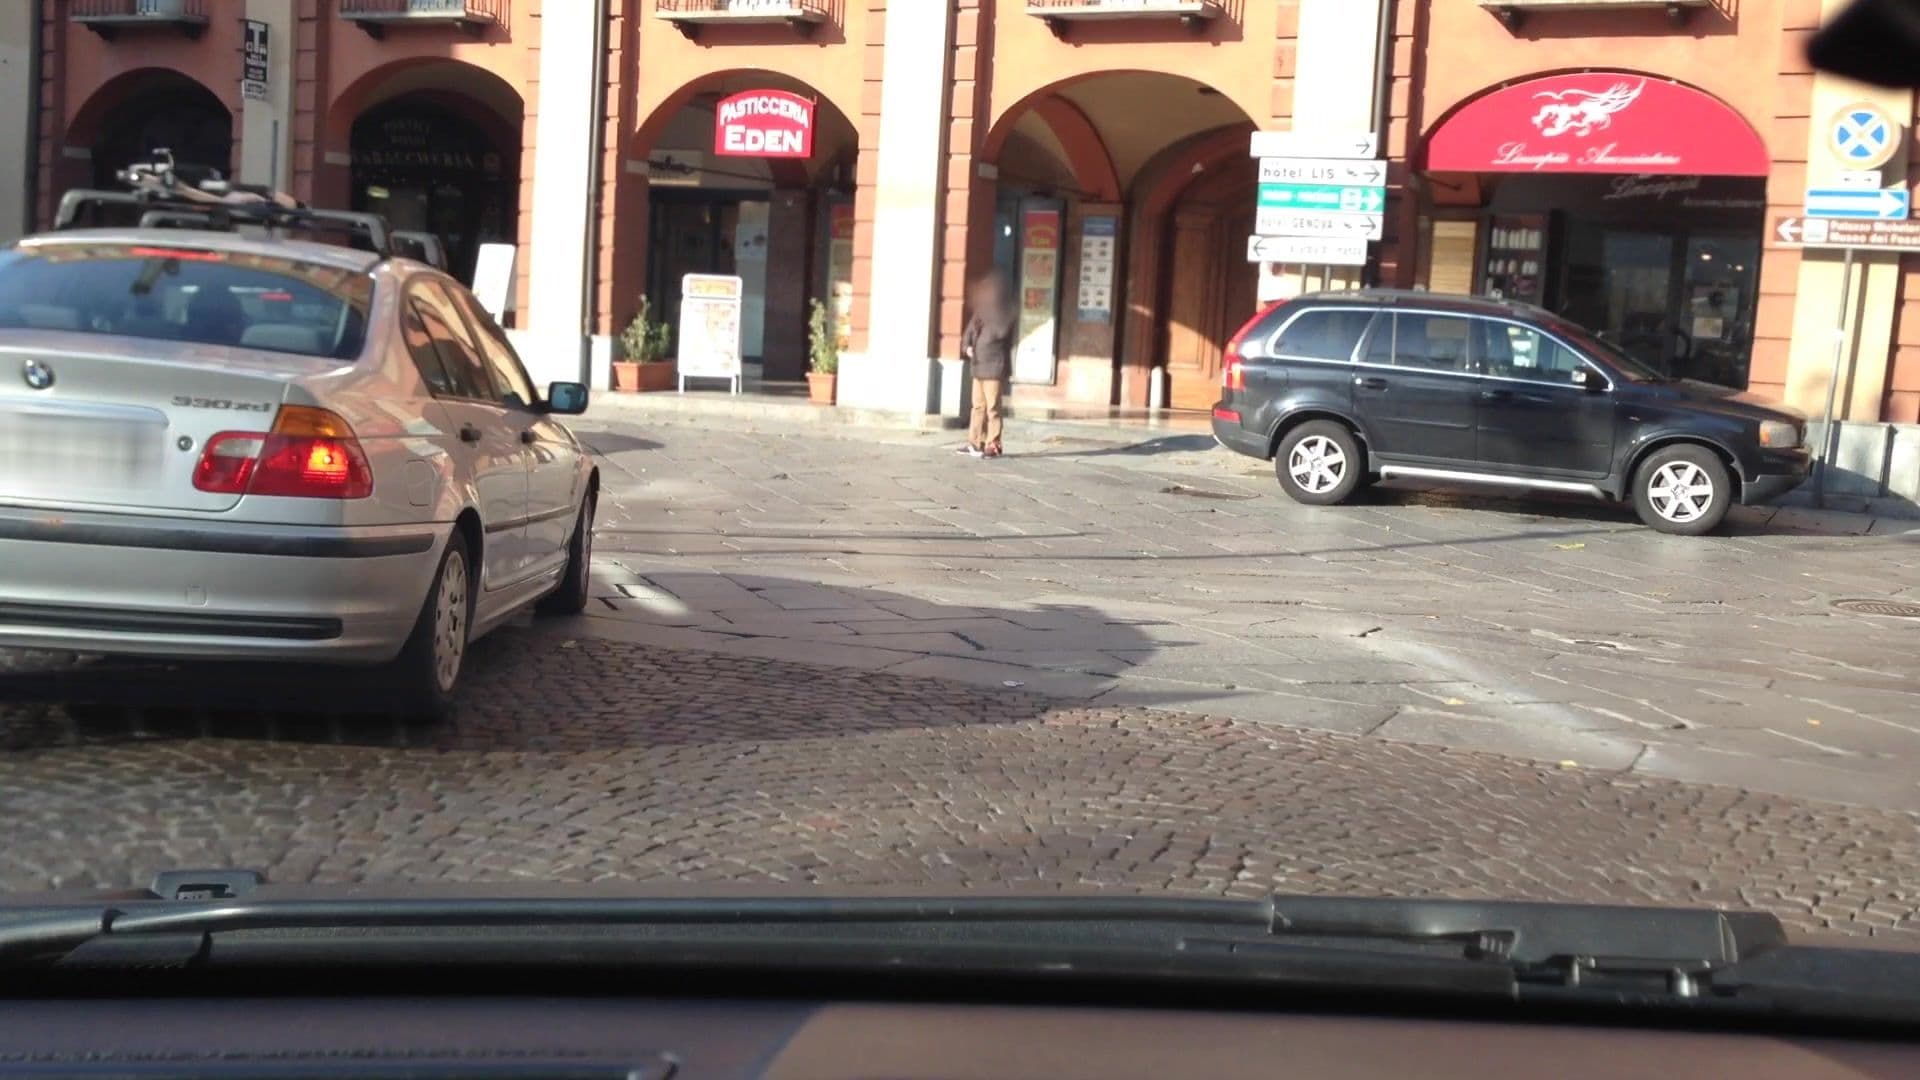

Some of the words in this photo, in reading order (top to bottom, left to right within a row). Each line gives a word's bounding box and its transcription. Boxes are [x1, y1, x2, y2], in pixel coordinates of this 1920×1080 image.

[720, 96, 809, 128] PASTICCERIA
[724, 124, 803, 153] EDEN
[1263, 167, 1302, 178] hotel
[1312, 168, 1335, 179] LIS
